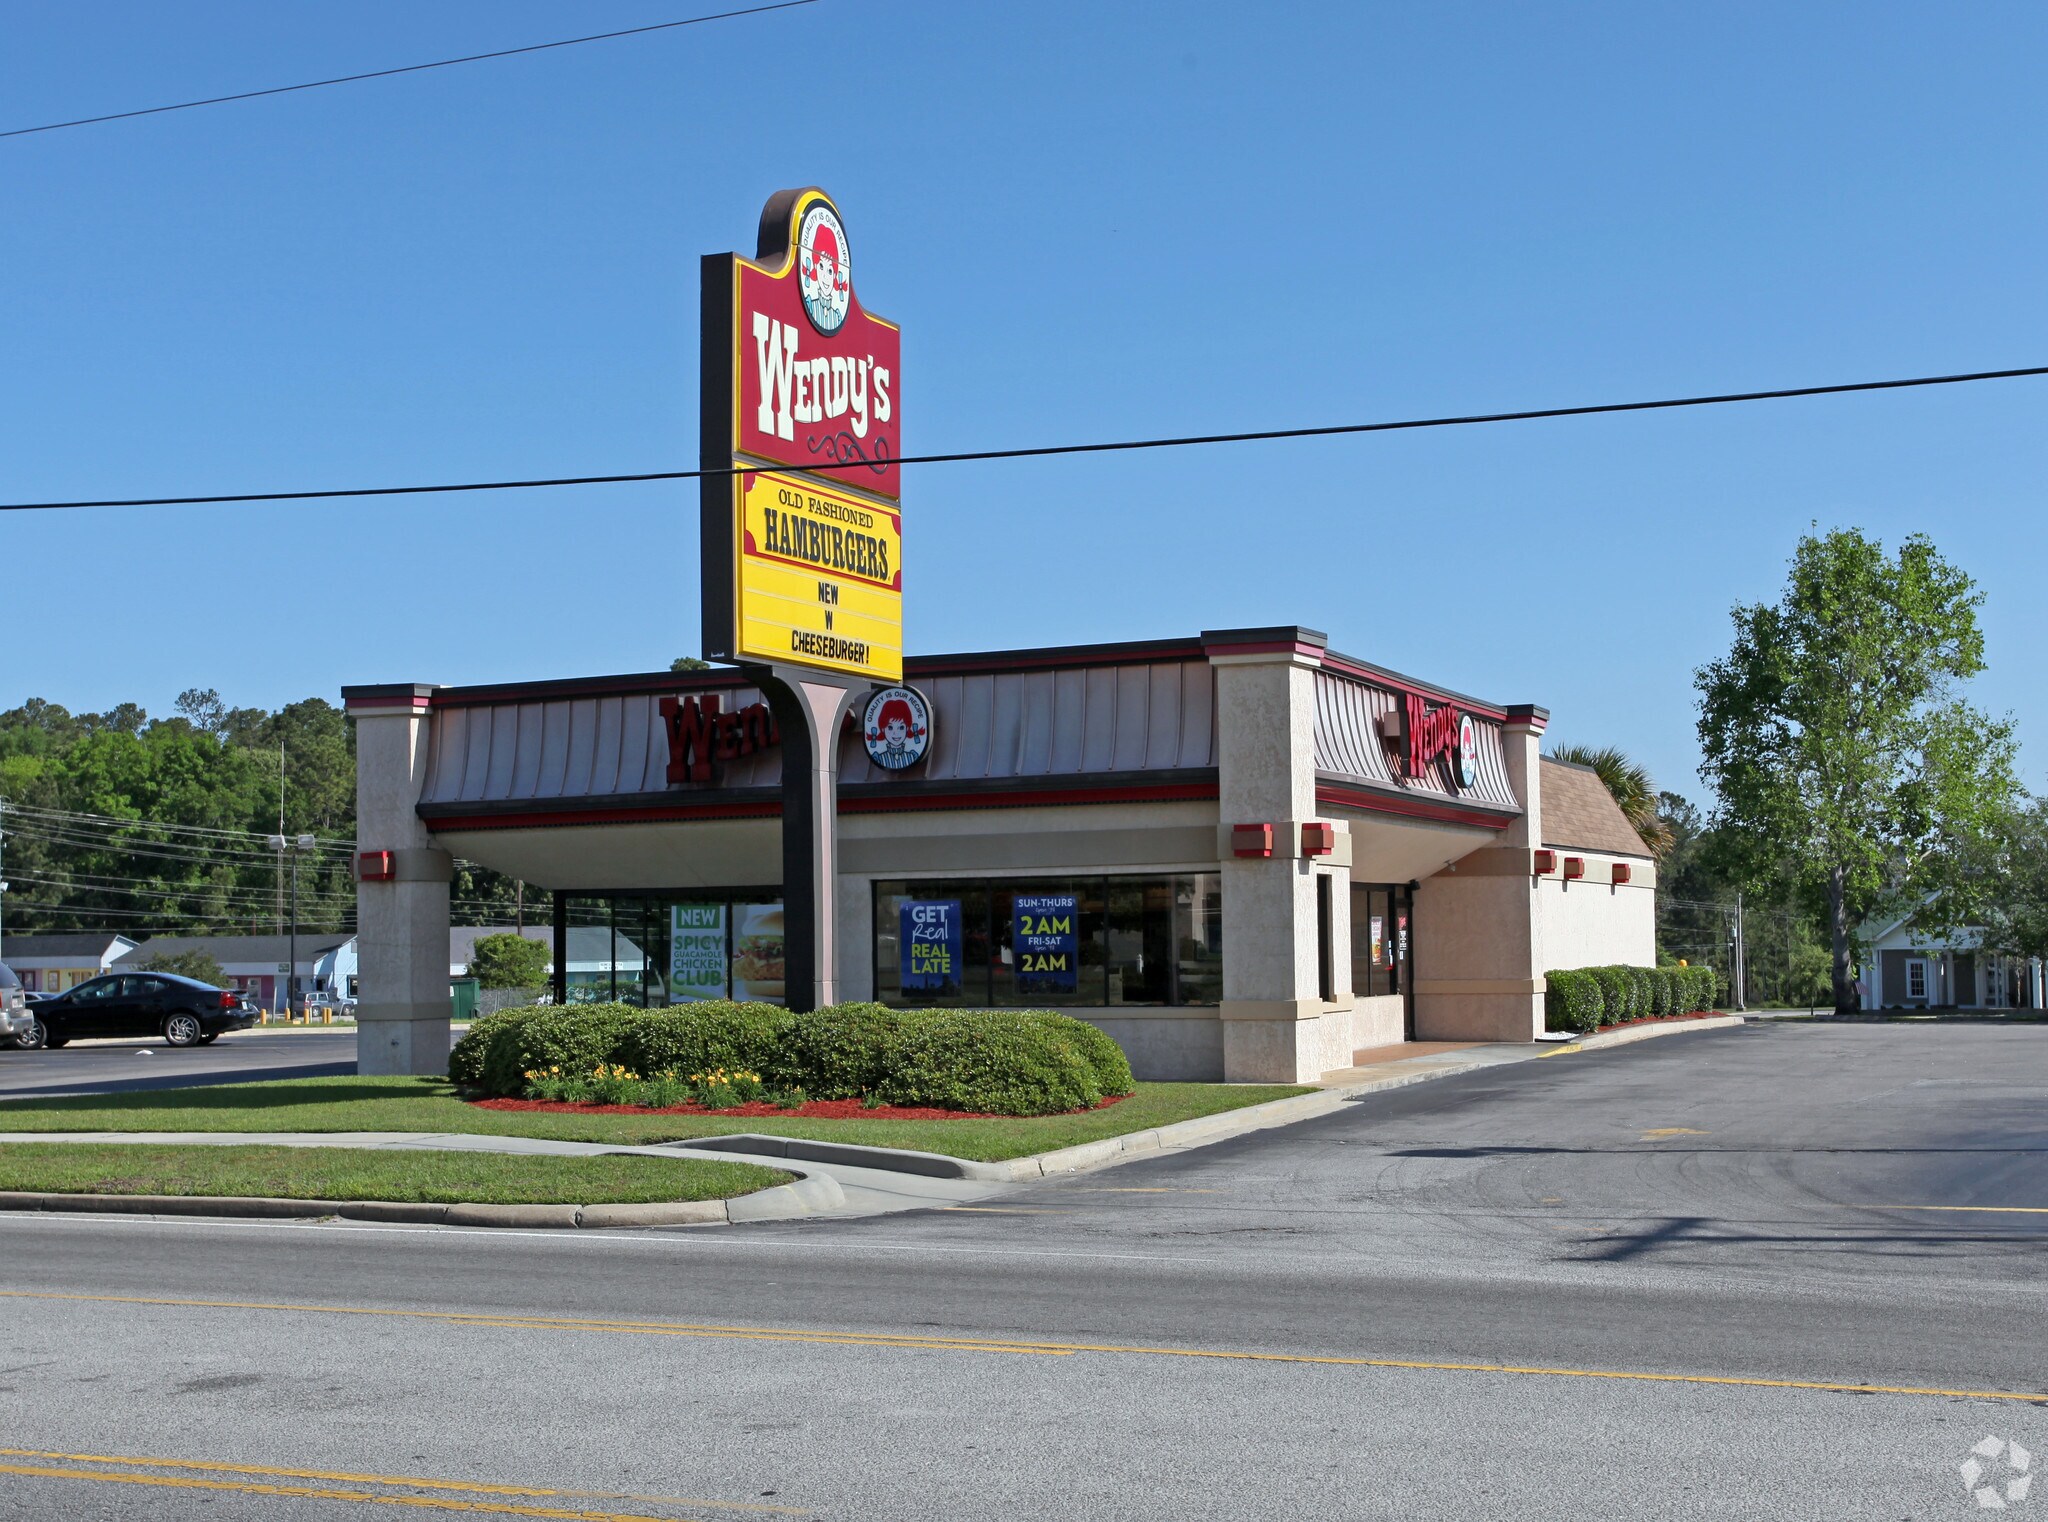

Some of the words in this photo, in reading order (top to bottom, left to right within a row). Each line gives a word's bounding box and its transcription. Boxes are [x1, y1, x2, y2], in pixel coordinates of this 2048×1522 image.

[803, 213, 818, 246] QUALITY
[818, 211, 825, 221] IS
[825, 213, 837, 230] OUR
[836, 229, 848, 265] RECIPE
[753, 311, 891, 442] Wendy's
[779, 489, 804, 509] OLD
[808, 497, 874, 529] FASHIONED
[764, 507, 889, 581] HAMBURGERS
[818, 582, 839, 605] NEW
[825, 610, 833, 630] W
[791, 630, 870, 664] CHEESEBURGER!
[867, 696, 885, 722] QUALITY
[895, 691, 909, 699] OUR
[909, 696, 924, 719] RECIPE
[1018, 898, 1073, 908] SUN-THURS
[681, 909, 716, 926] NEW
[912, 906, 949, 923] GET
[912, 919, 949, 943] Real
[674, 935, 723, 950] SPICY
[1028, 937, 1062, 945] FRI-SAT
[911, 944, 950, 958] REAL
[673, 959, 722, 969] CHICKEN
[911, 958, 950, 974] LATE
[673, 970, 722, 986] CLUB
